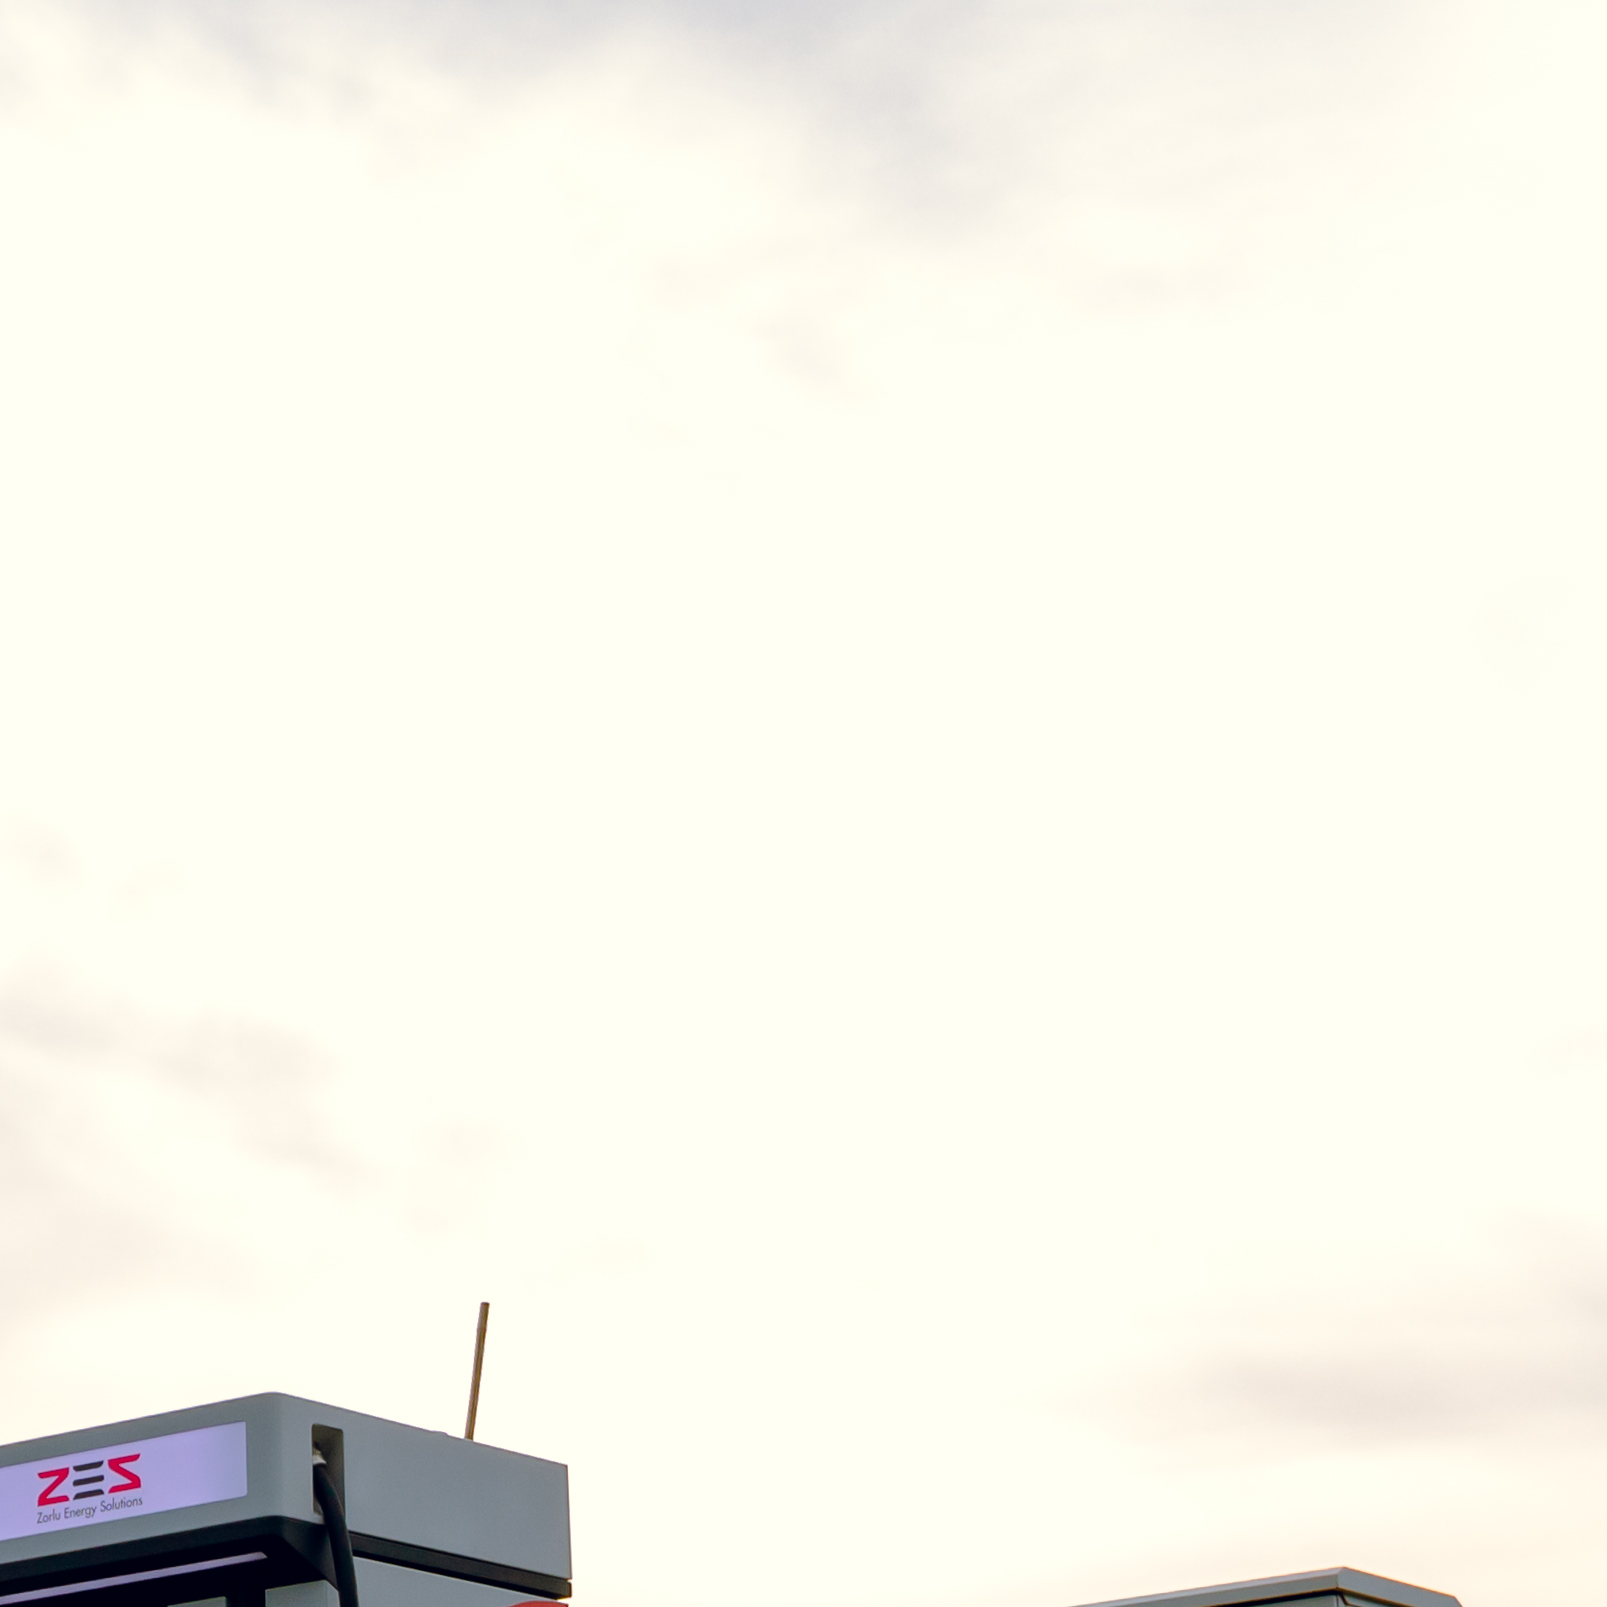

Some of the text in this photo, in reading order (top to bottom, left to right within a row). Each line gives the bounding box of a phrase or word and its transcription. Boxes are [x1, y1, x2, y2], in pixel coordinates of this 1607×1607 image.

[37, 1453, 142, 1507] ZES
[37, 1497, 143, 1524] Zorlu Energy Solutions
